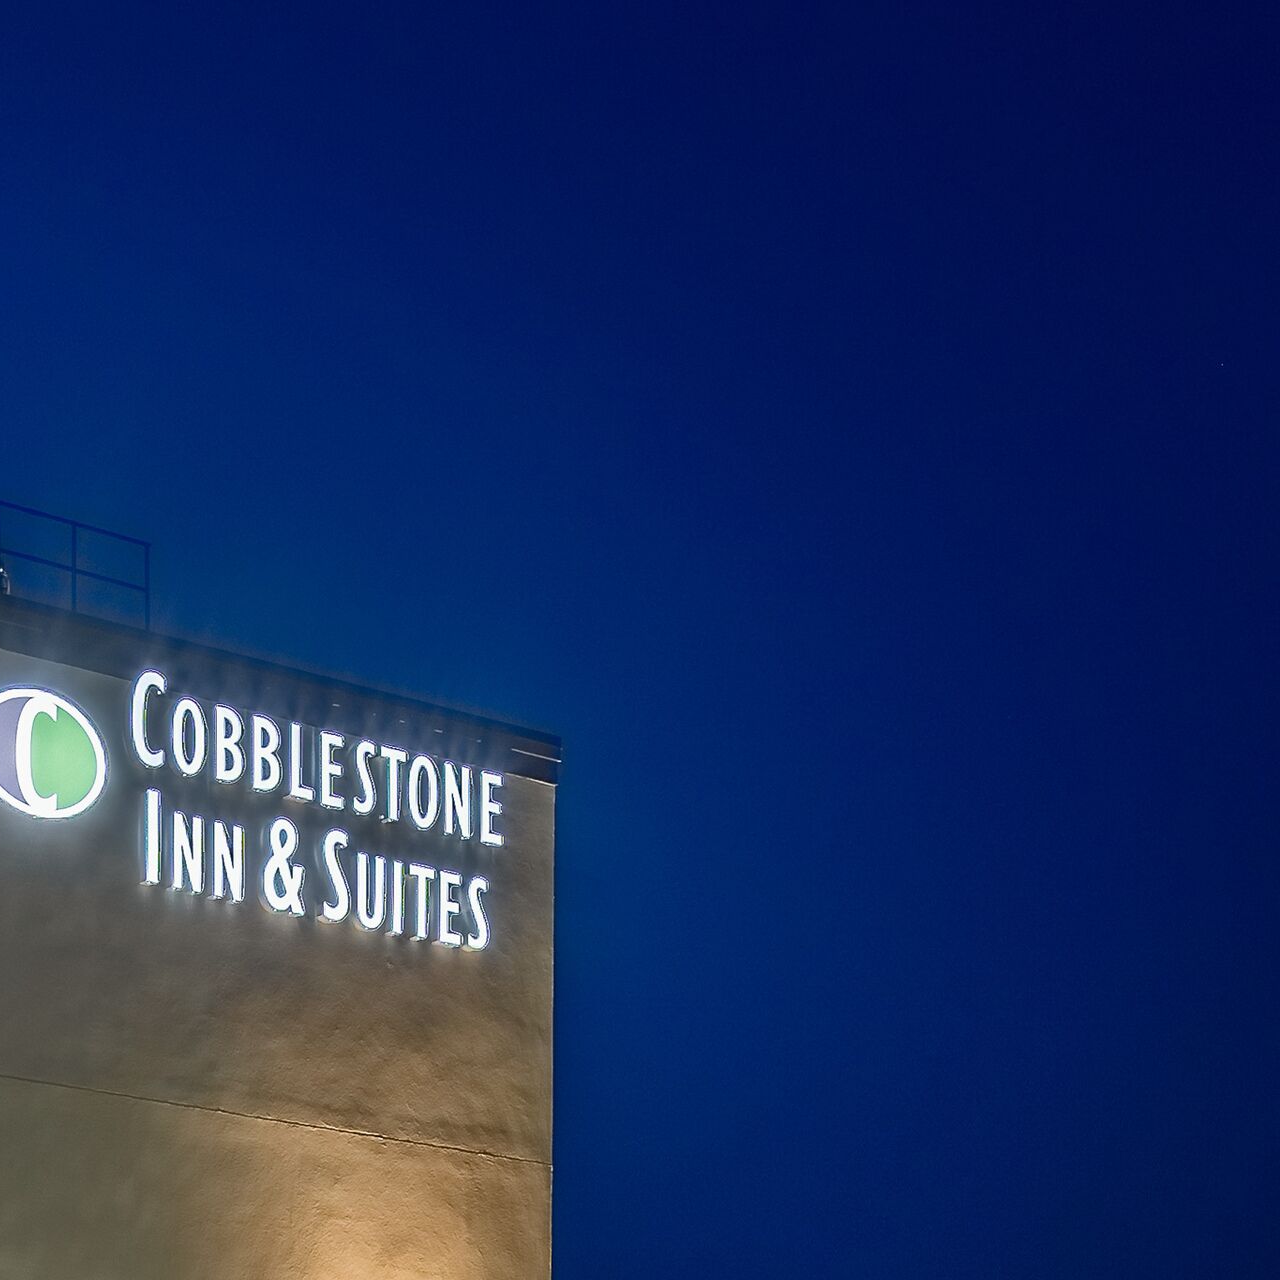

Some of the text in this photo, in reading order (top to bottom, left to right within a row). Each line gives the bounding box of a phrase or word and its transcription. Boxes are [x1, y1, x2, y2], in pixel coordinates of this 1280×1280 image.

[131, 670, 504, 846] COBBLESTONE
[145, 788, 489, 951] INN & SUITES
